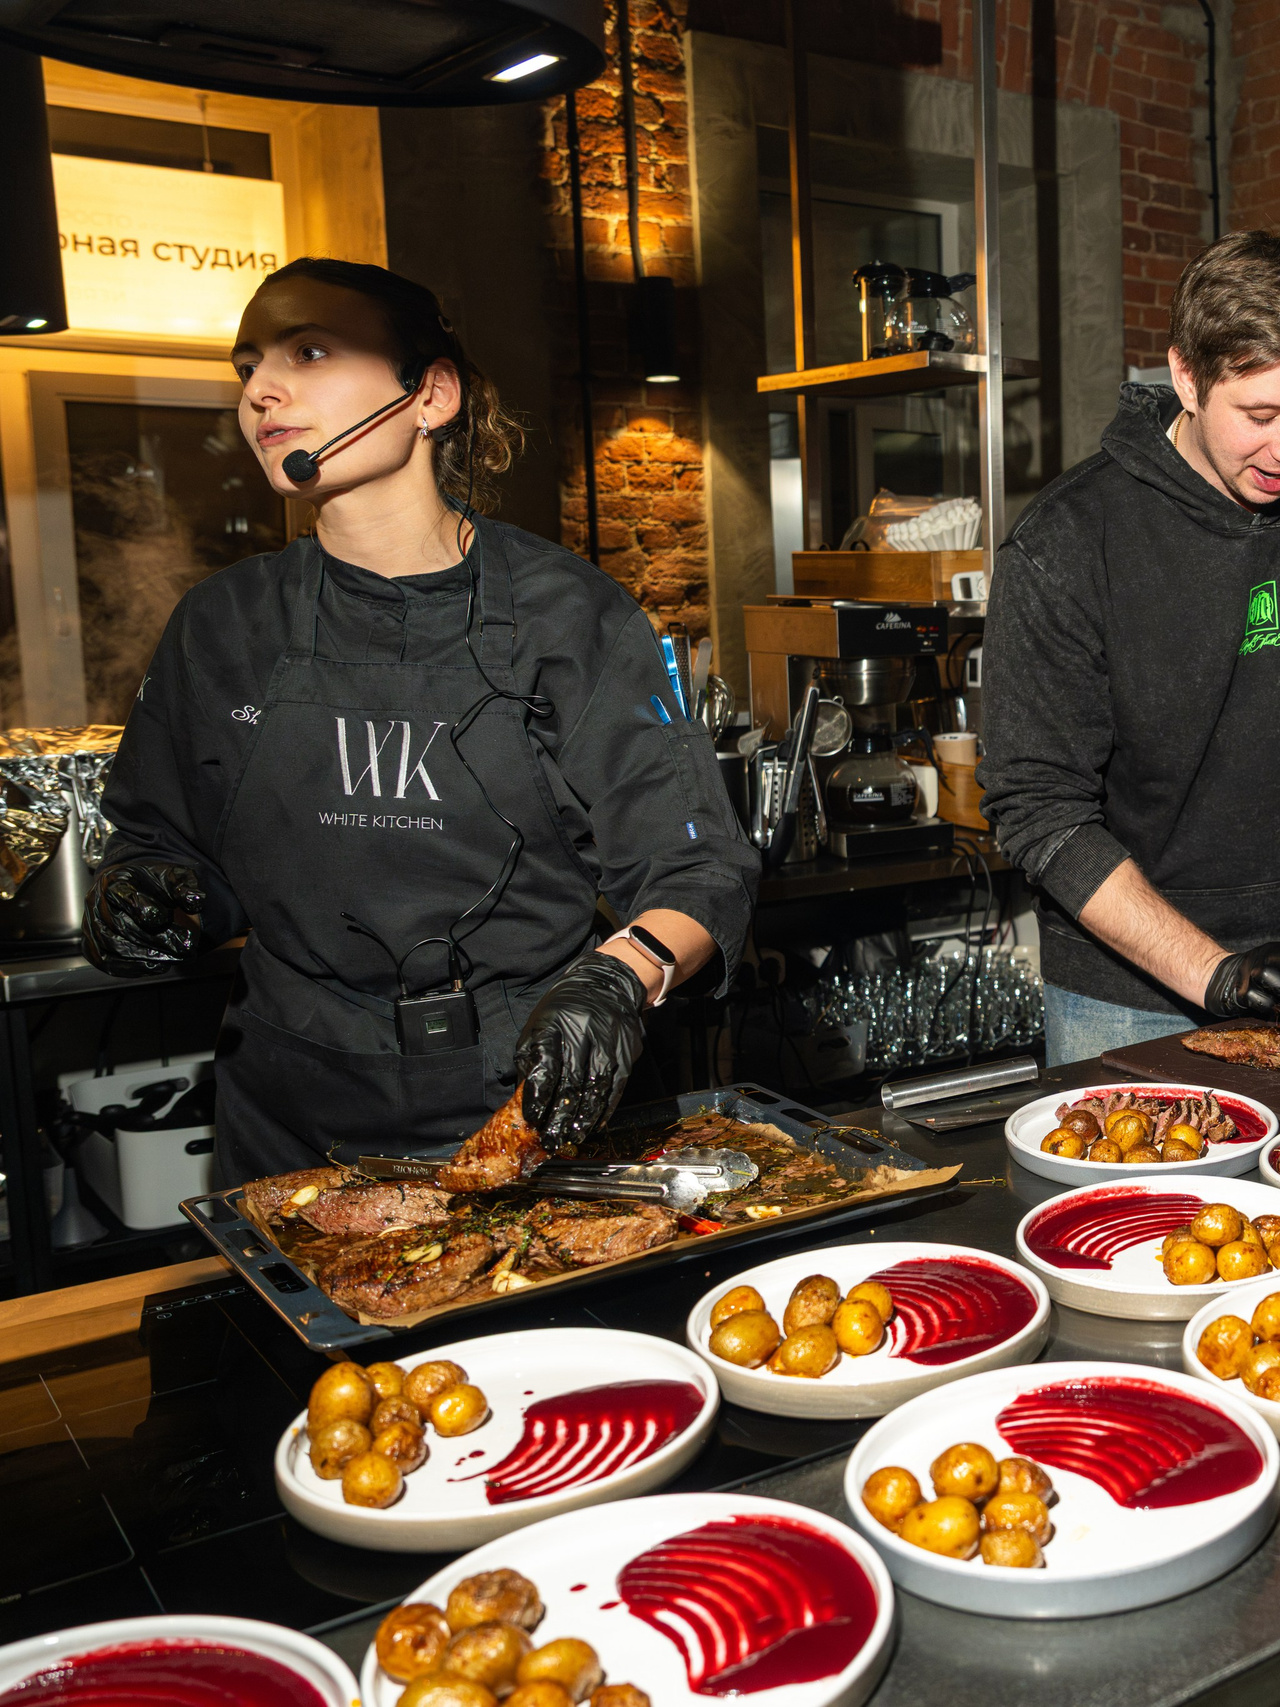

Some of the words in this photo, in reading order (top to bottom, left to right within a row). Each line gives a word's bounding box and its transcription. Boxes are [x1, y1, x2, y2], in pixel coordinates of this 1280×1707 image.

[153, 242, 277, 271] студия
[876, 622, 911, 630] CAFERINA
[335, 716, 447, 801] WK
[319, 812, 368, 827] WHITE
[372, 814, 443, 831] KITCHEN
